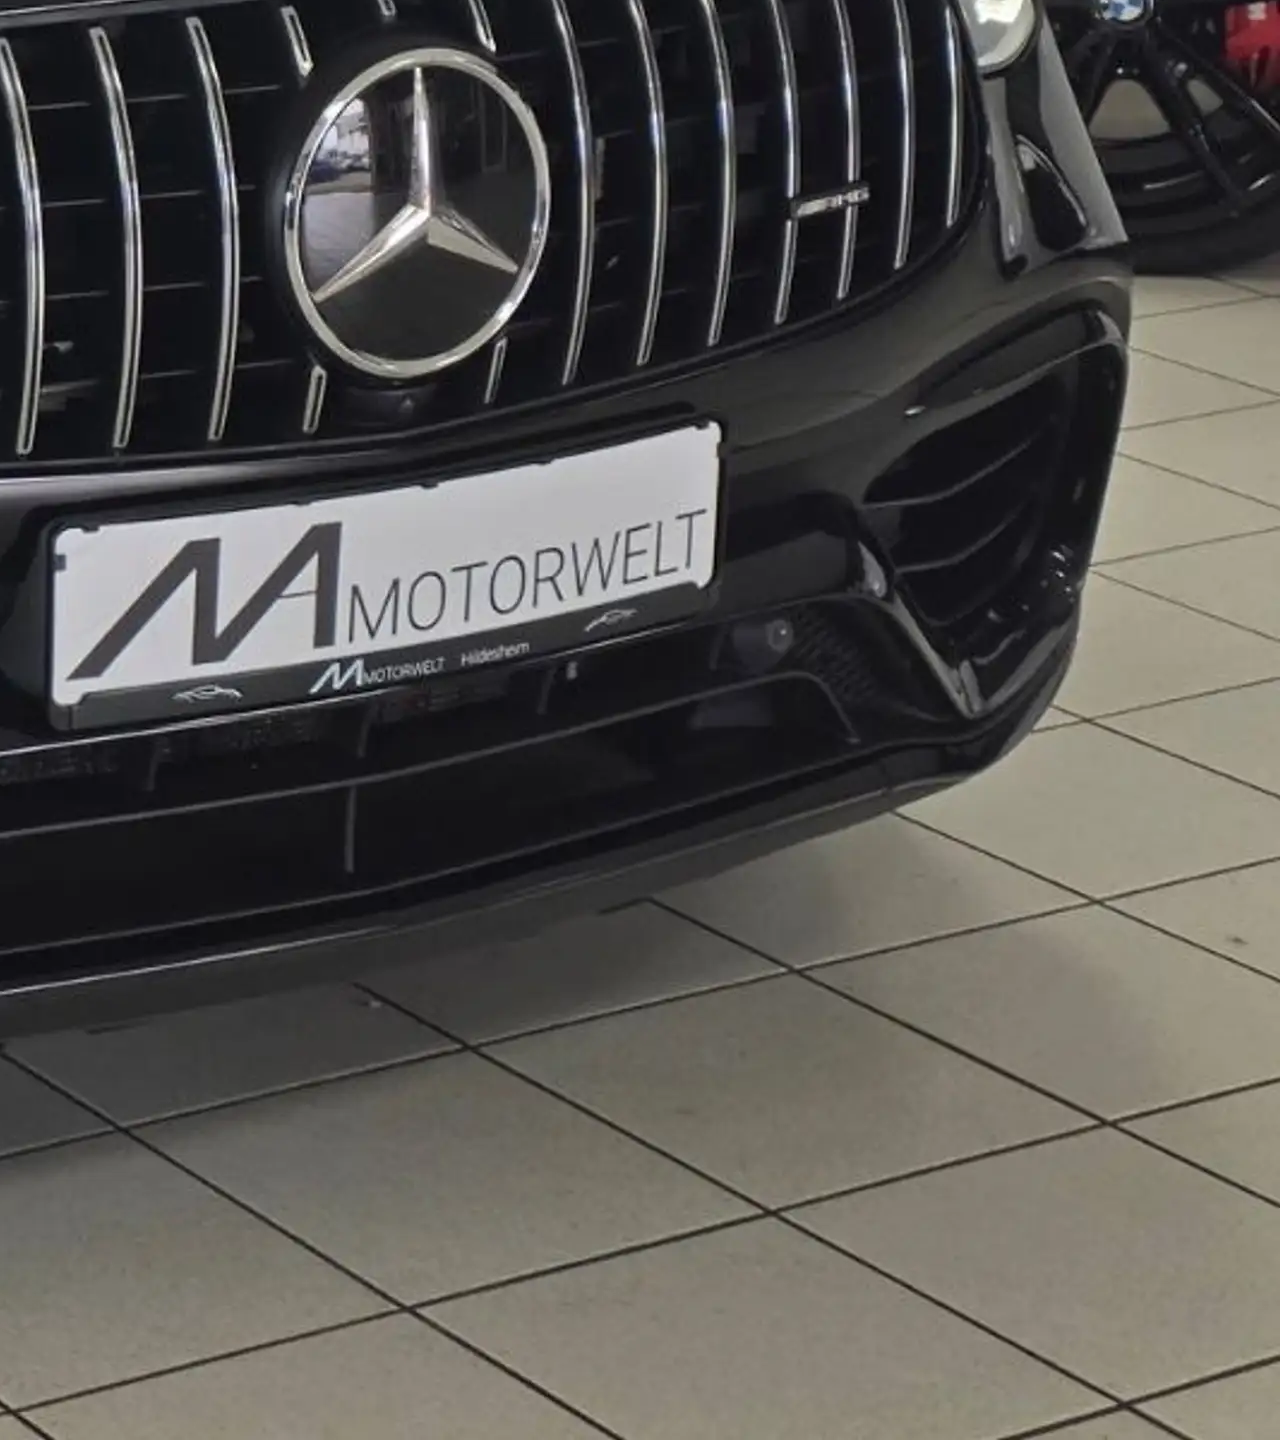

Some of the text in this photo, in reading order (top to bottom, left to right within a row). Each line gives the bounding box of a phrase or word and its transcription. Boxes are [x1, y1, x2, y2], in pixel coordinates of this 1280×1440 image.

[348, 509, 708, 644] MOTORWELT
[363, 658, 445, 684] MOTORWELT
[460, 641, 531, 668] Hildesheim
